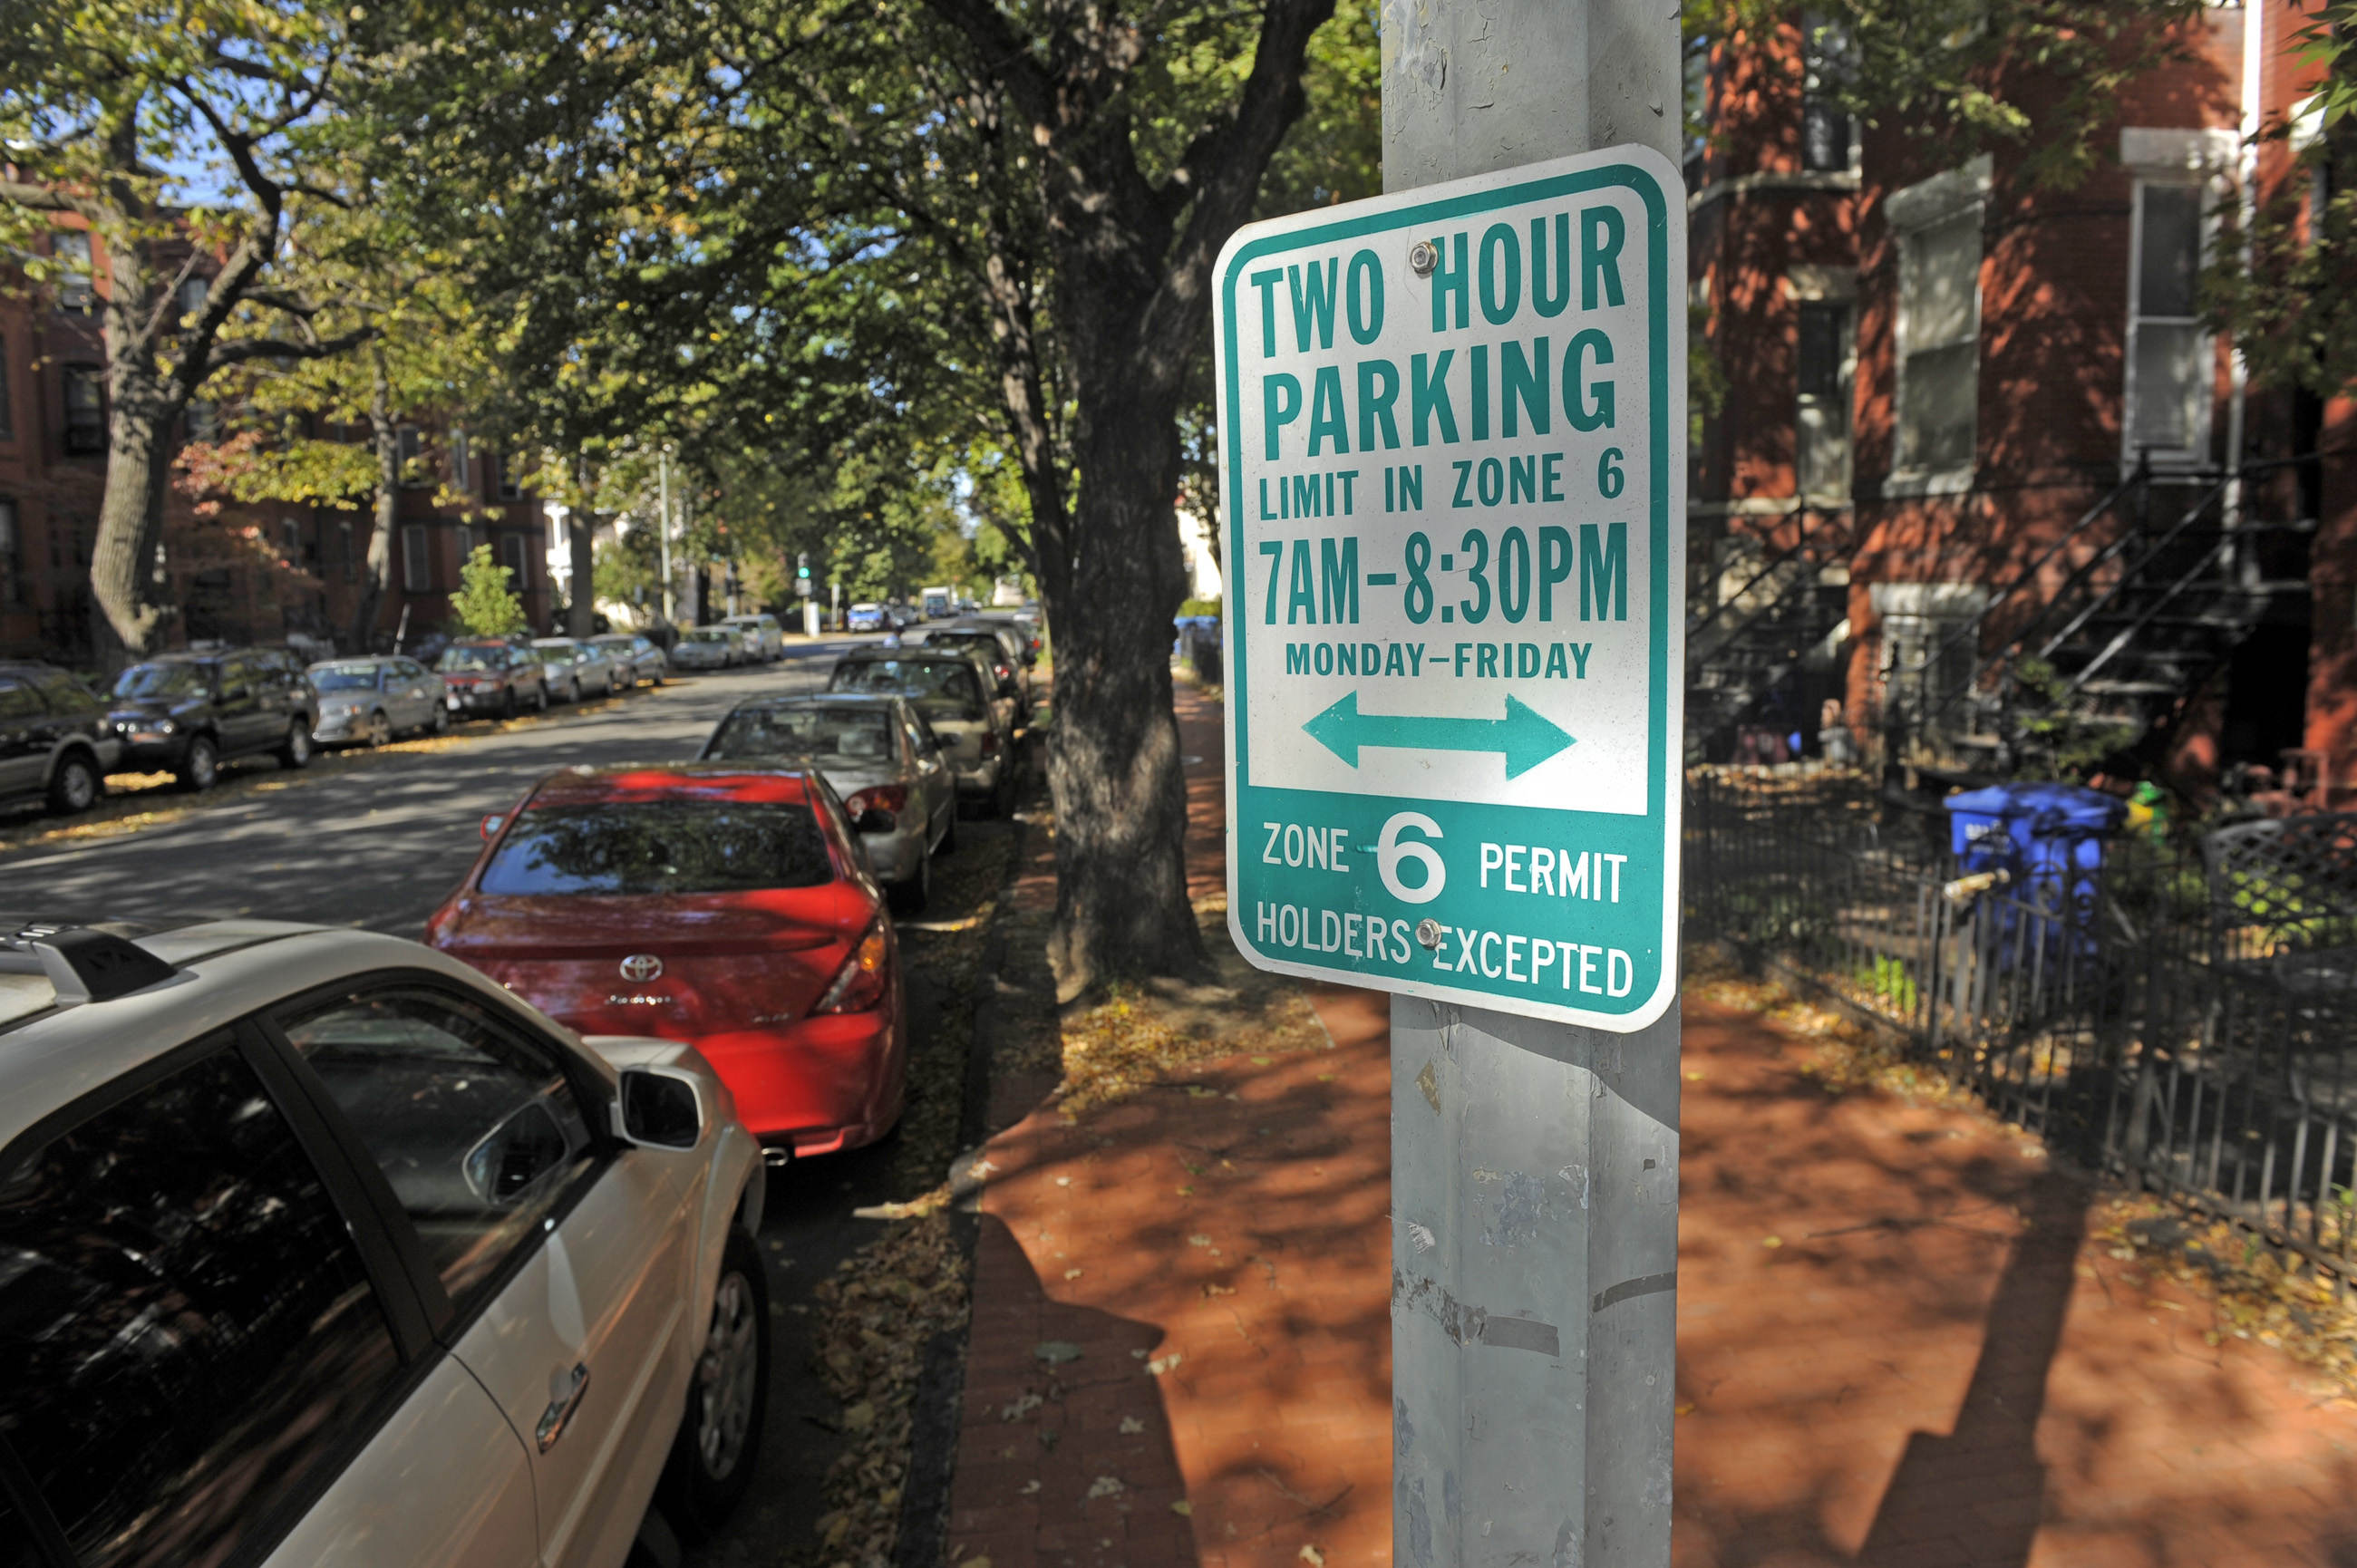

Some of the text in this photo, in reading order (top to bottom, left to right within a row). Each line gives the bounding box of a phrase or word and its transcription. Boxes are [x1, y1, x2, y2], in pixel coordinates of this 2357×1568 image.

[1251, 205, 1625, 358] TWO HOUR
[1263, 328, 1615, 461] PARKING
[1259, 447, 1625, 521] LIMIT IN ZONE 6
[1262, 812, 1628, 905] ZONE 6 PERMIT
[1256, 901, 1634, 998] HOLDERS EXCEPTED
